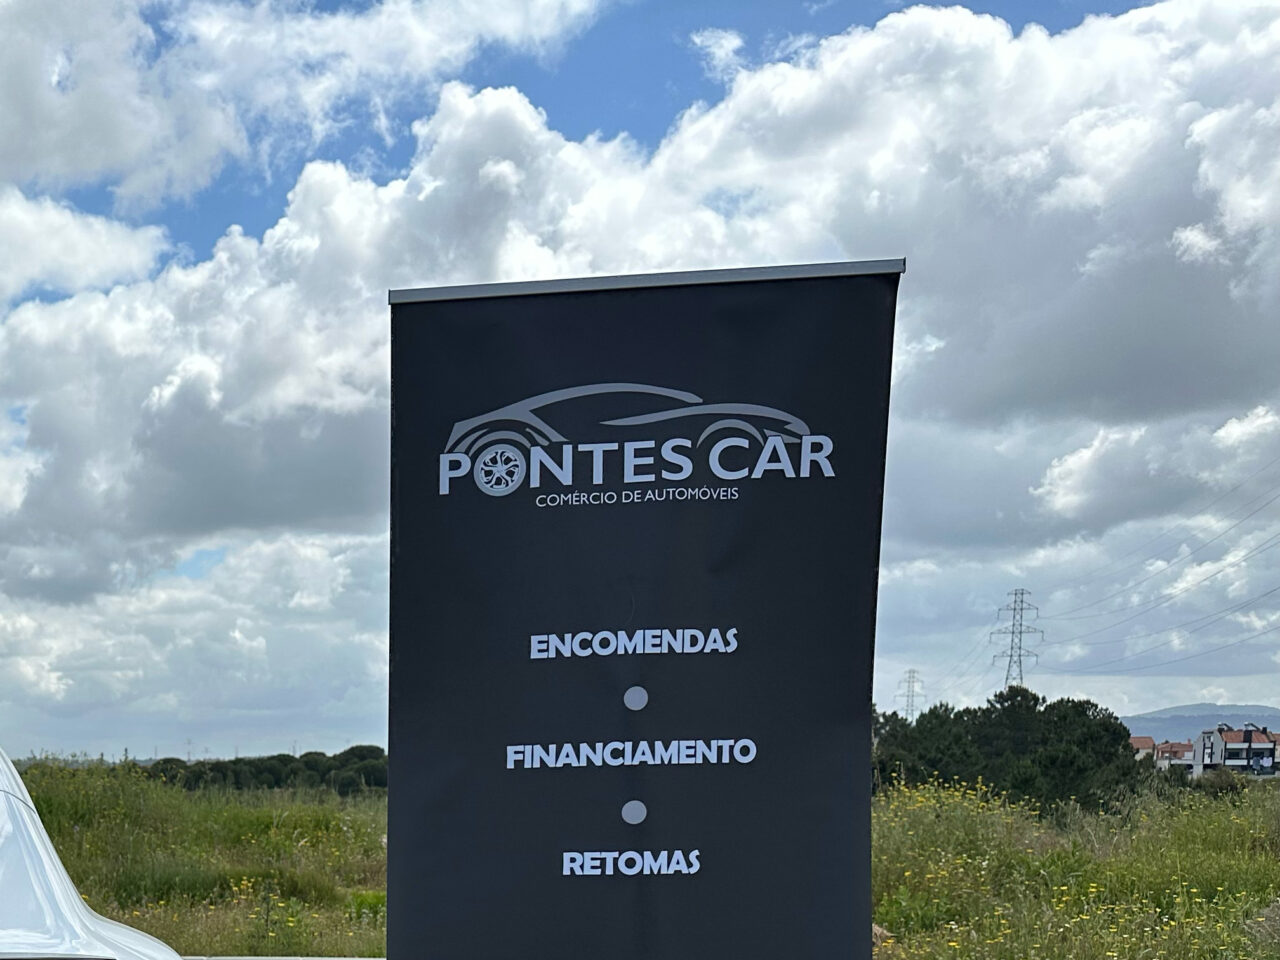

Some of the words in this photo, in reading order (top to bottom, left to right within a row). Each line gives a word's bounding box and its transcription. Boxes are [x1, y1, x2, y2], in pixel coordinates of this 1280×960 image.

[439, 438, 693, 497] PONTES
[708, 434, 835, 480] CAR
[535, 490, 617, 507] COMÉRCIO
[622, 490, 641, 503] DE
[644, 485, 739, 501] AUTOMÓVEIS
[530, 628, 738, 659] ENCOMENDAS
[506, 739, 757, 769] FINANCIAMENTO
[562, 850, 700, 875] RETOMAS
